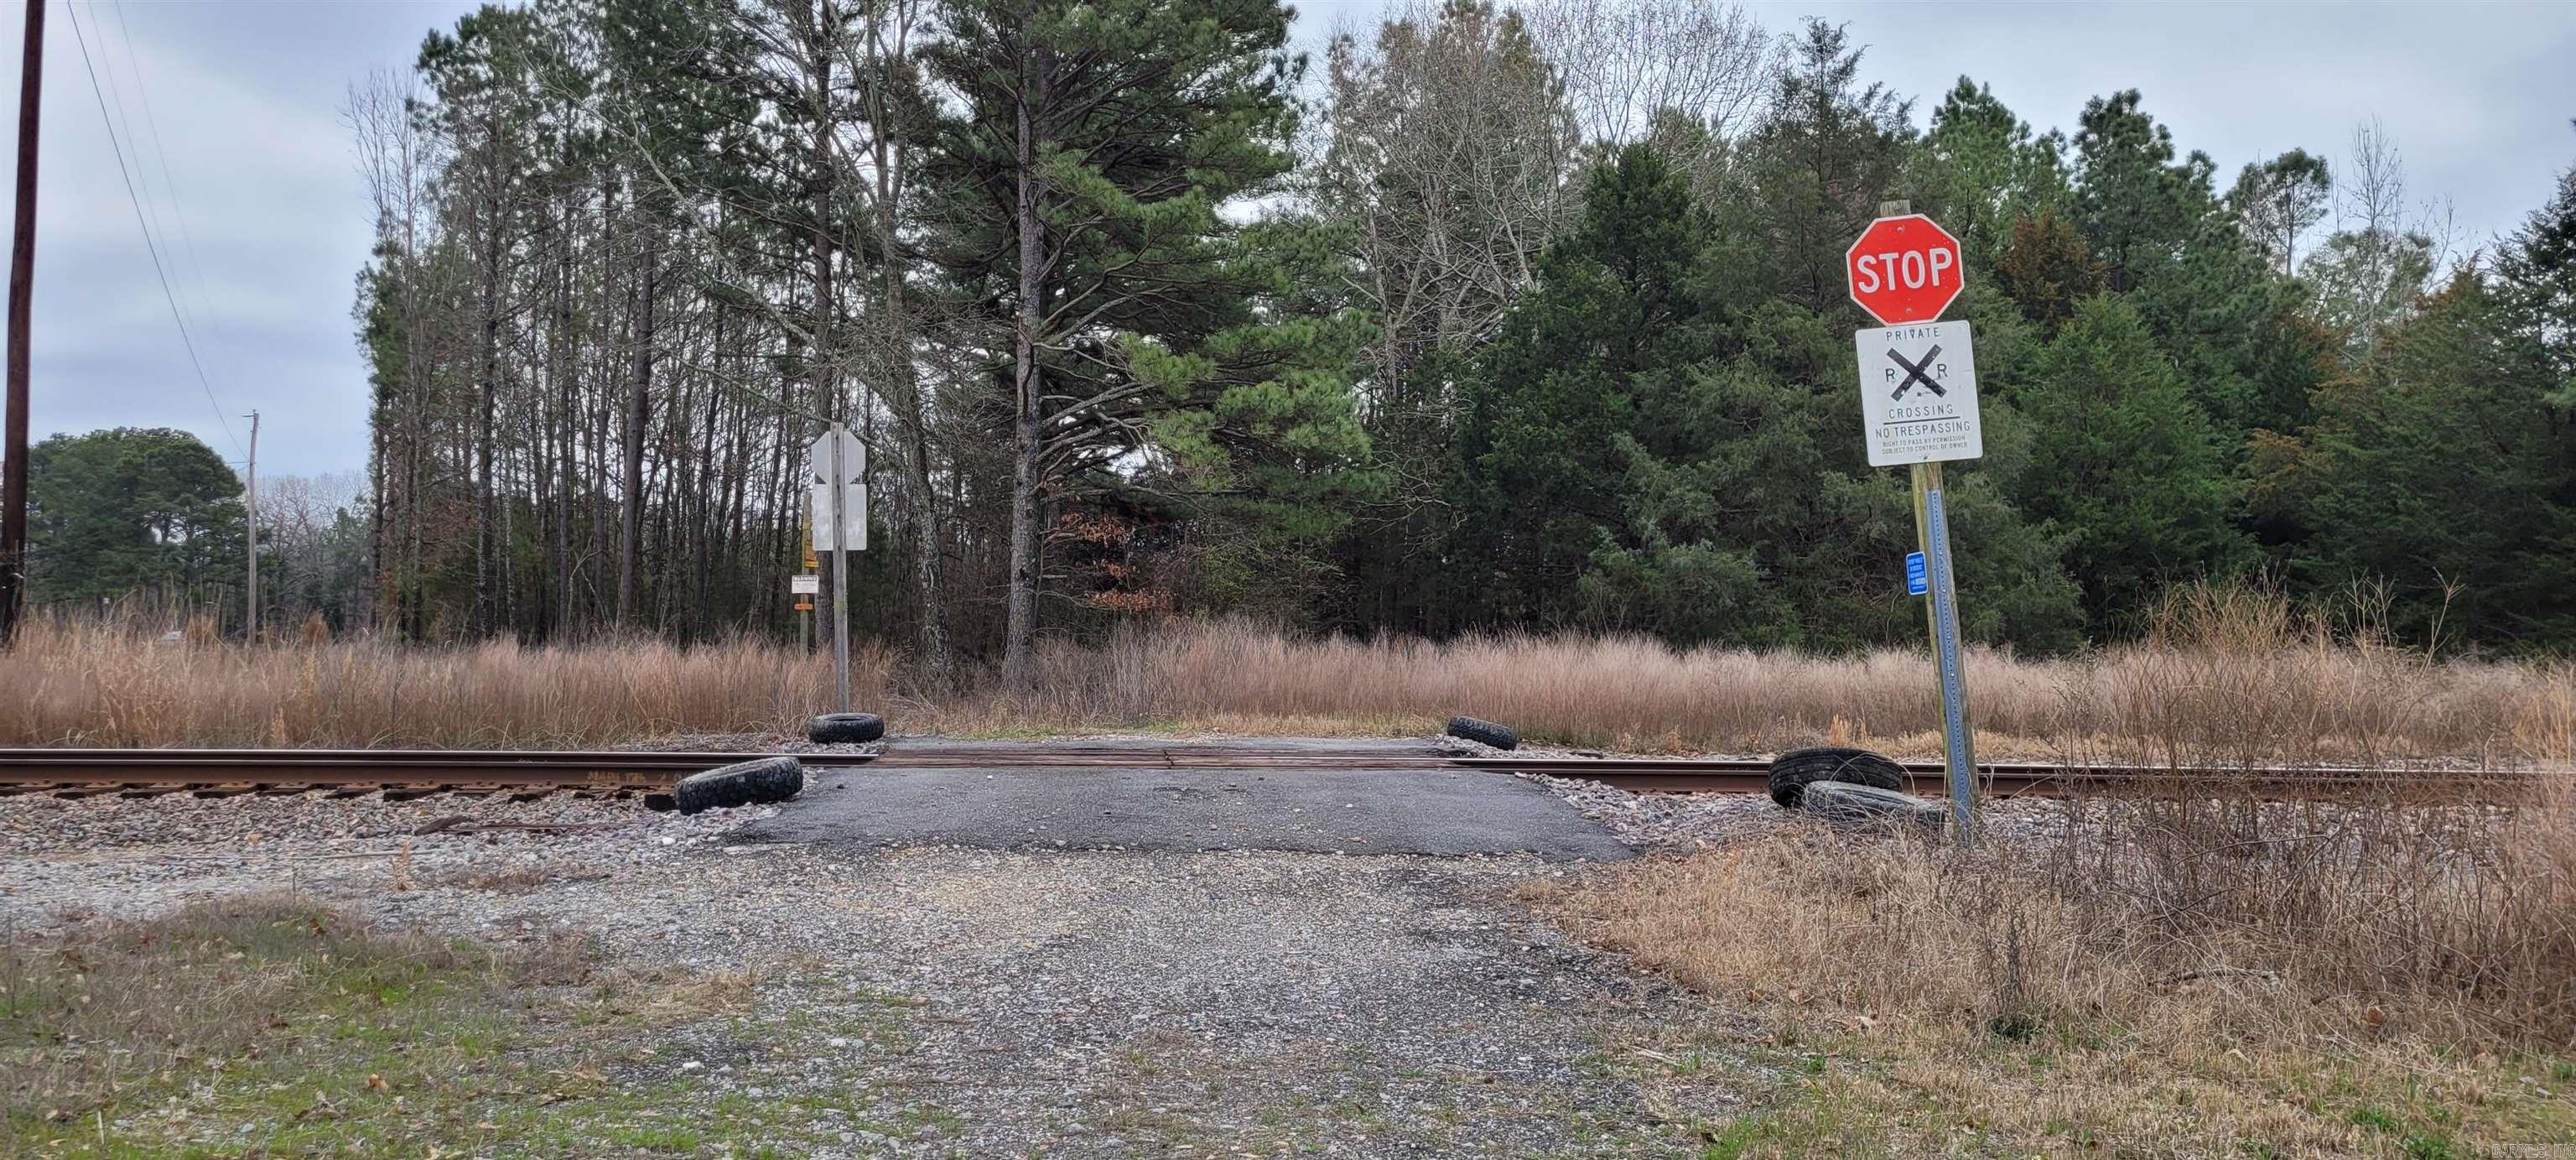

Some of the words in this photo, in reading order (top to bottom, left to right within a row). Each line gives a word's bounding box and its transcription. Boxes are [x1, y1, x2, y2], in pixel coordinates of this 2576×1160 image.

[1857, 247, 1952, 294] STOP
[1886, 327, 1940, 341] PRIVATE
[1885, 368, 1895, 382] R
[1937, 363, 1948, 378] R
[1888, 403, 1953, 419] CROSSING
[1875, 428, 1890, 439] NO
[1894, 421, 1971, 436] TRESPASSING
[1932, 434, 1966, 443] PERMISSION
